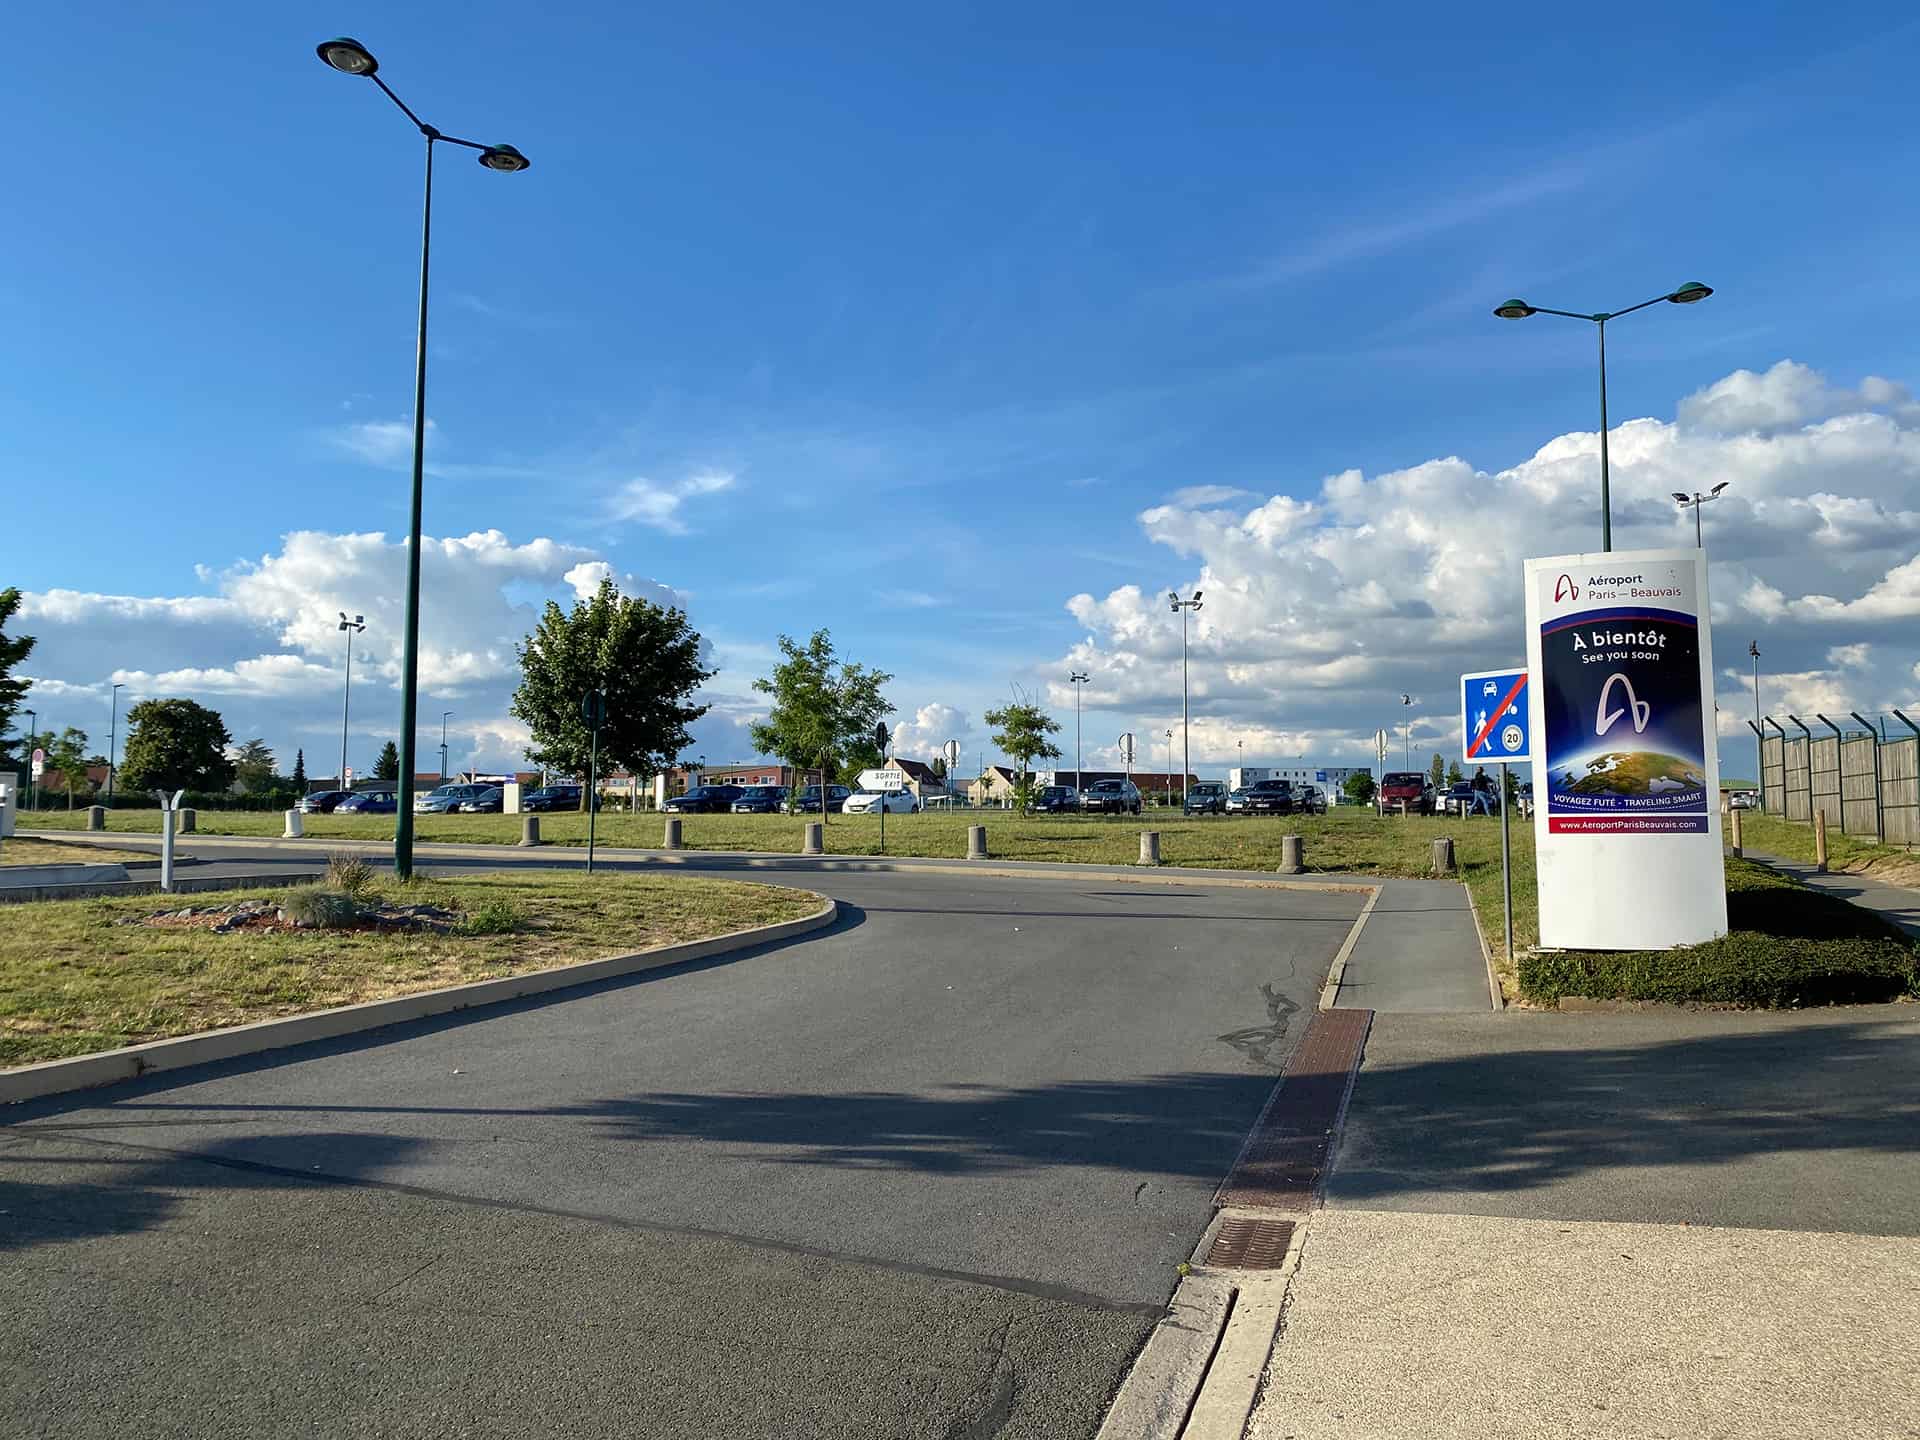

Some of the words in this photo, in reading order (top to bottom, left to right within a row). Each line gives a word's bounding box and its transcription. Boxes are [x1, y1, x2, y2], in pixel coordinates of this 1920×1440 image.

[1588, 574, 1643, 587] Aéroport
[1588, 590, 1616, 600] Paris
[1631, 587, 1681, 598] Beauvais
[1573, 632, 1587, 651] À
[1592, 630, 1667, 648] bientôt
[1581, 652, 1604, 664] See
[1606, 651, 1628, 661] you
[1631, 651, 1660, 661] soon
[1506, 733, 1519, 743] 20
[1554, 793, 1592, 806] VOYAGEZ
[1594, 798, 1616, 807] FUTÉ
[1624, 797, 1671, 807] TRAVELING
[1672, 792, 1701, 804] SMART
[1559, 821, 1697, 830] www.AeroportParisBeauvais.com
